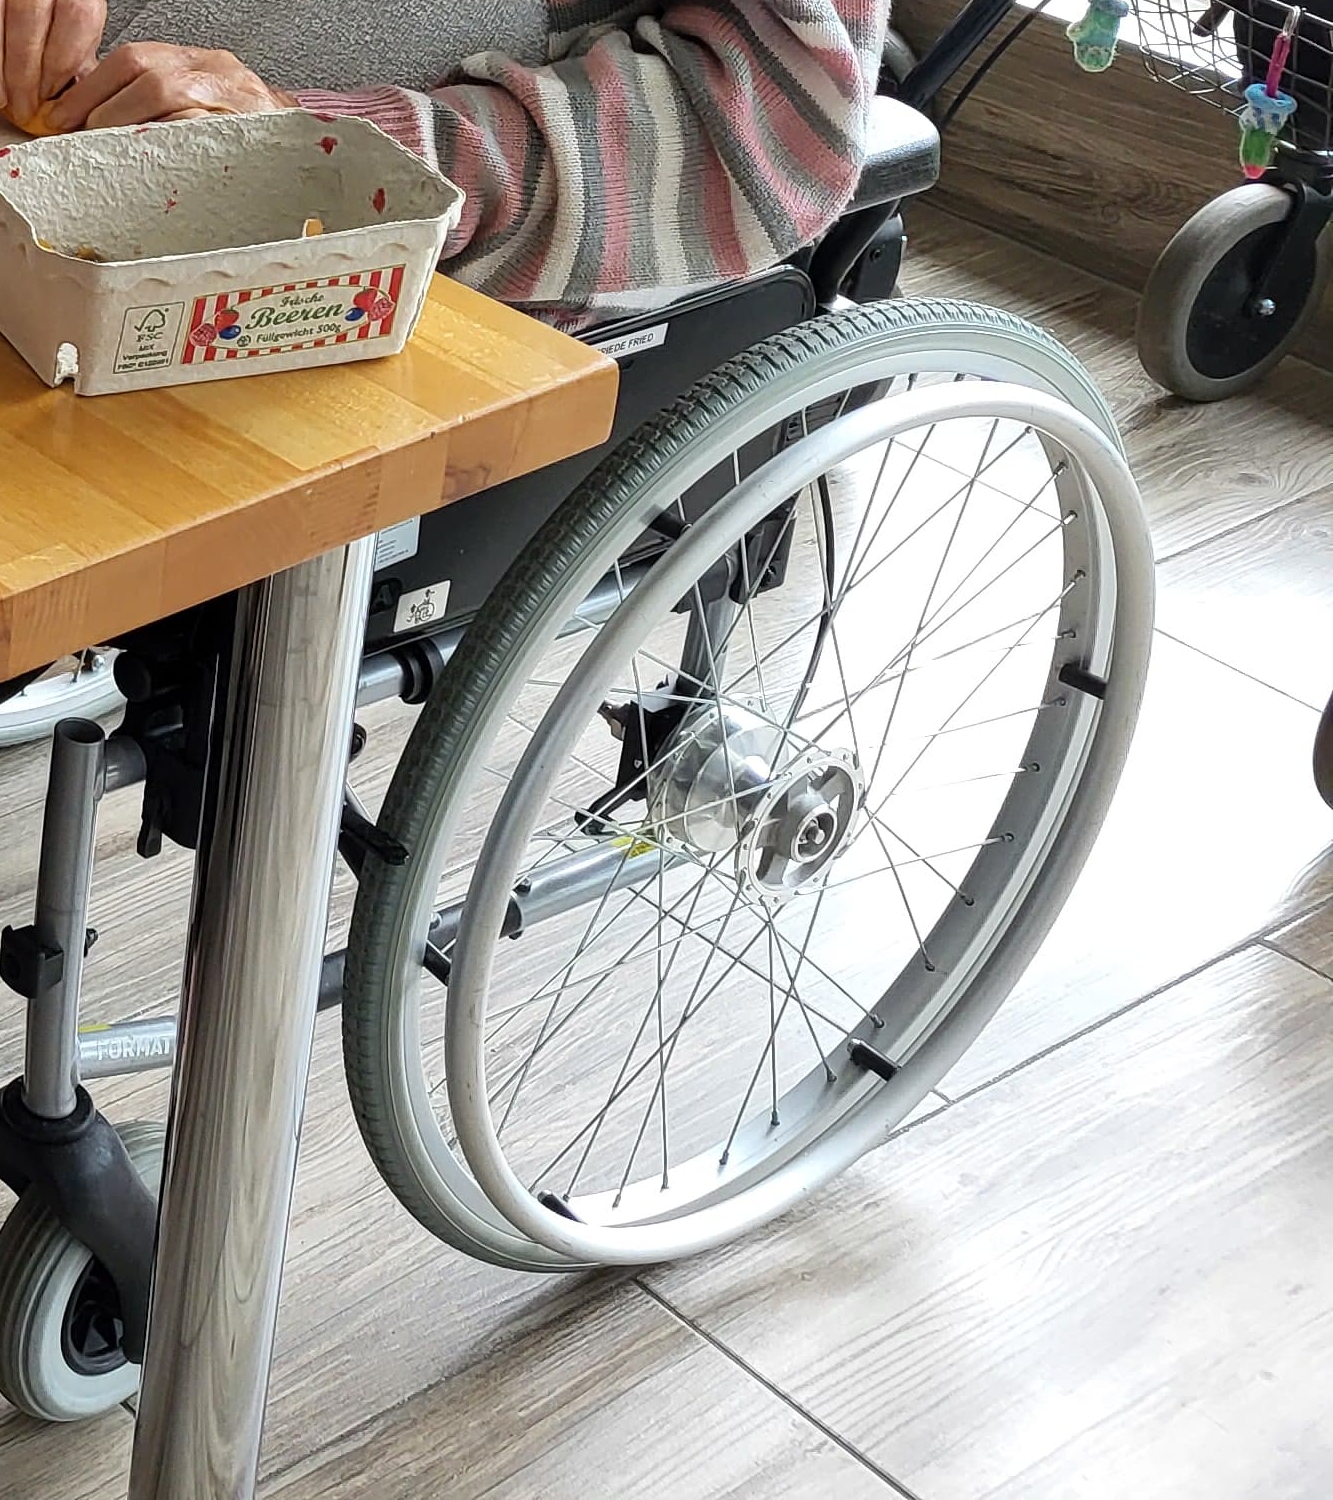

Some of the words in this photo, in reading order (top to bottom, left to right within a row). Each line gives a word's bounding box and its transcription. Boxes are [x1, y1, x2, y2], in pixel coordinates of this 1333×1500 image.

[279, 292, 324, 307] Frische
[244, 303, 345, 329] Beeren
[257, 327, 314, 343] Füllgewicht
[597, 340, 626, 355] RIEDE
[97, 1036, 171, 1061] FORMAT
